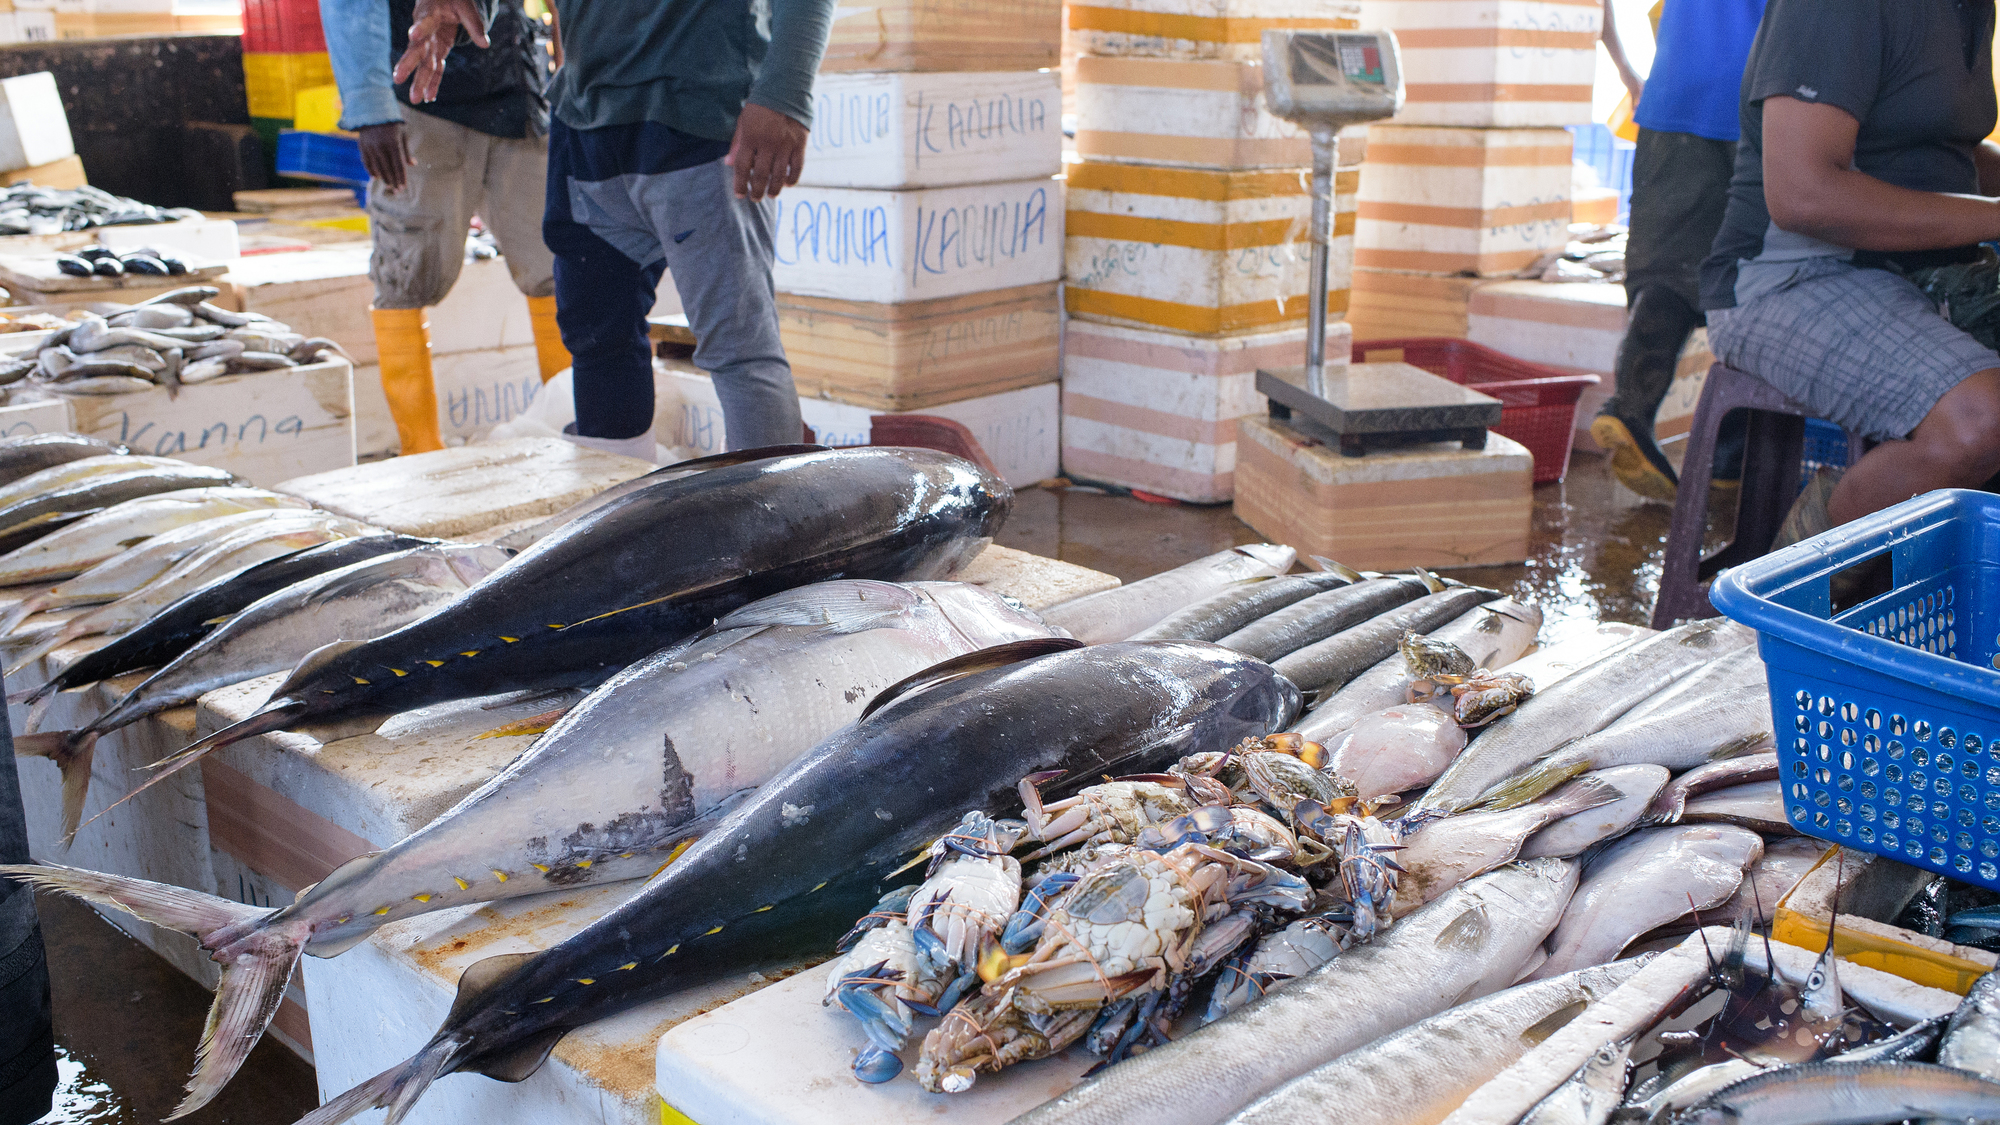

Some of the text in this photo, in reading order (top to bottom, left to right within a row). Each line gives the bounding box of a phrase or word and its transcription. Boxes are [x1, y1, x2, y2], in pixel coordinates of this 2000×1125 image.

[812, 92, 891, 151] NNA
[914, 91, 1046, 170] KANNA
[912, 187, 1047, 288] KANNA
